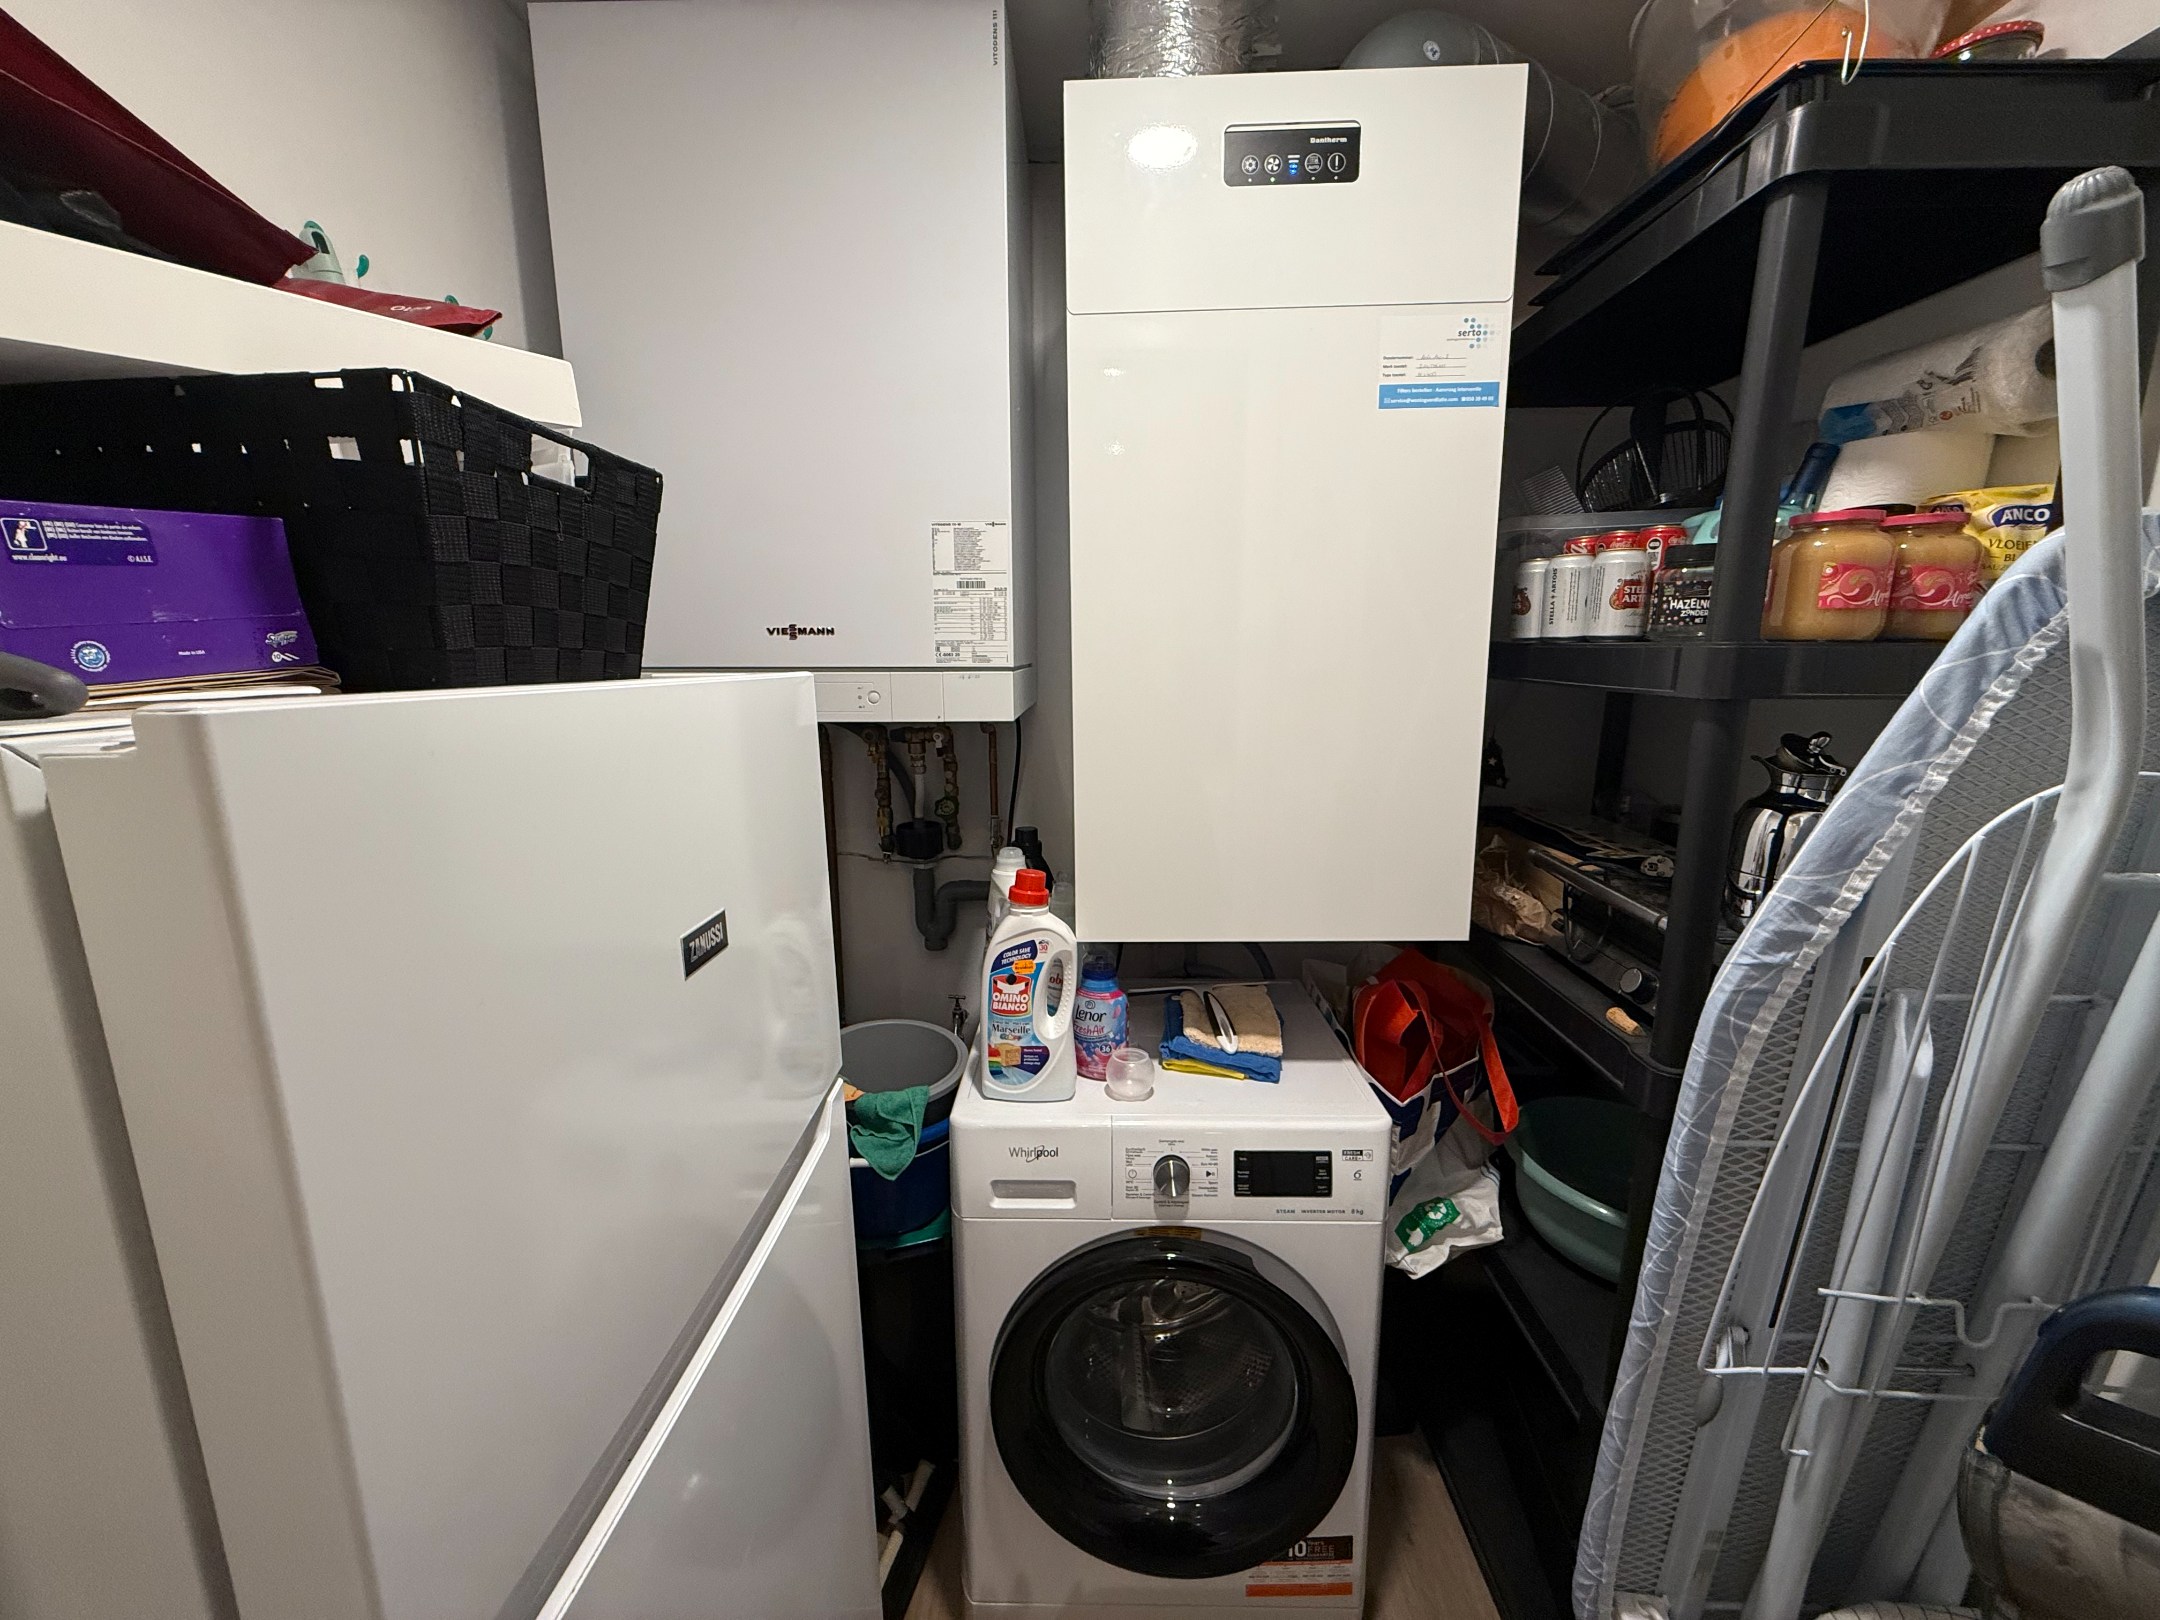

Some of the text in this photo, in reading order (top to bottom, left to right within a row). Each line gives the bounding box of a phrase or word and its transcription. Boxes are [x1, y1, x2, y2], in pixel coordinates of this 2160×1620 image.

[1457, 329, 1482, 337] serto
[2000, 507, 2051, 524] ANCO
[1988, 538, 2037, 551] VLOEIE
[2004, 553, 2017, 562] BL
[1623, 585, 1648, 594] STEL
[1548, 567, 1558, 626] STELLA ARTOIS
[765, 623, 836, 641] VIESSMANN
[688, 921, 724, 963] ZANUSSI
[1001, 953, 1032, 966] TECHNOLOGY
[1002, 949, 1019, 959] COLOR
[992, 992, 1029, 1003] OMINO
[992, 1002, 1028, 1012] BIANCO
[1075, 1003, 1107, 1022] Lenor
[992, 1022, 1031, 1035] Marseille
[1101, 1045, 1111, 1053] 36
[1008, 1144, 1059, 1163] Whirlpool
[1353, 1169, 1362, 1180] 6
[1307, 1545, 1335, 1553] FREE
